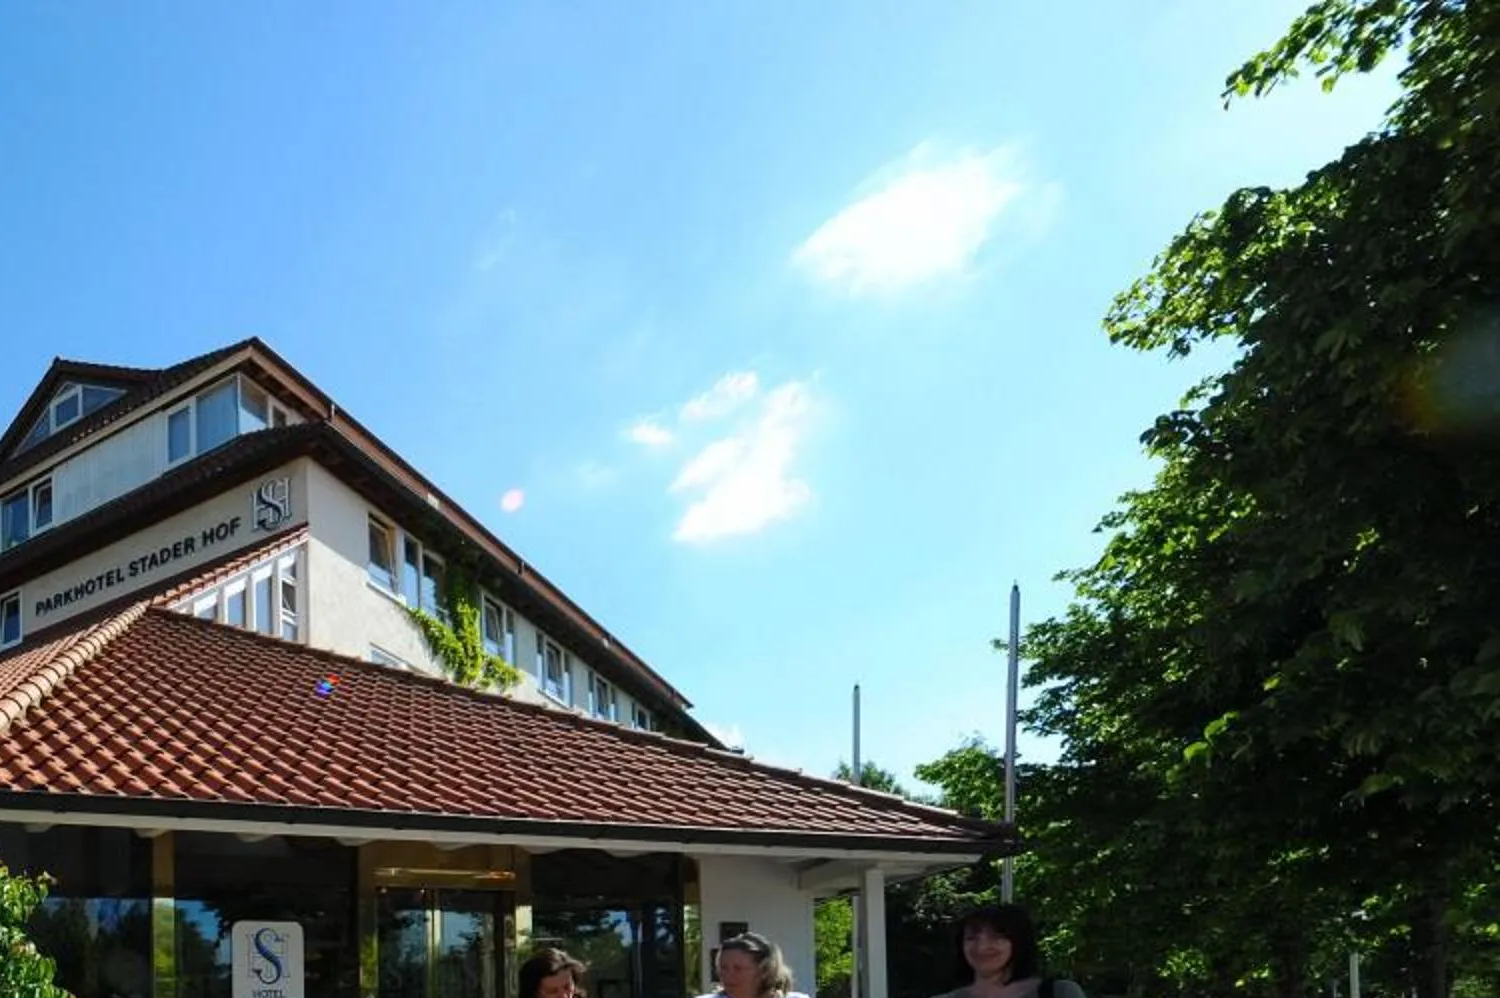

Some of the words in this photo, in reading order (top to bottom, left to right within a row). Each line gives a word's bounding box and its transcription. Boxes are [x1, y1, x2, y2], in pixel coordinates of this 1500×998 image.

[35, 568, 125, 617] PARKHOTEL
[129, 536, 196, 578] STADER
[202, 516, 242, 547] HOF
[252, 989, 286, 998] HOTEL
